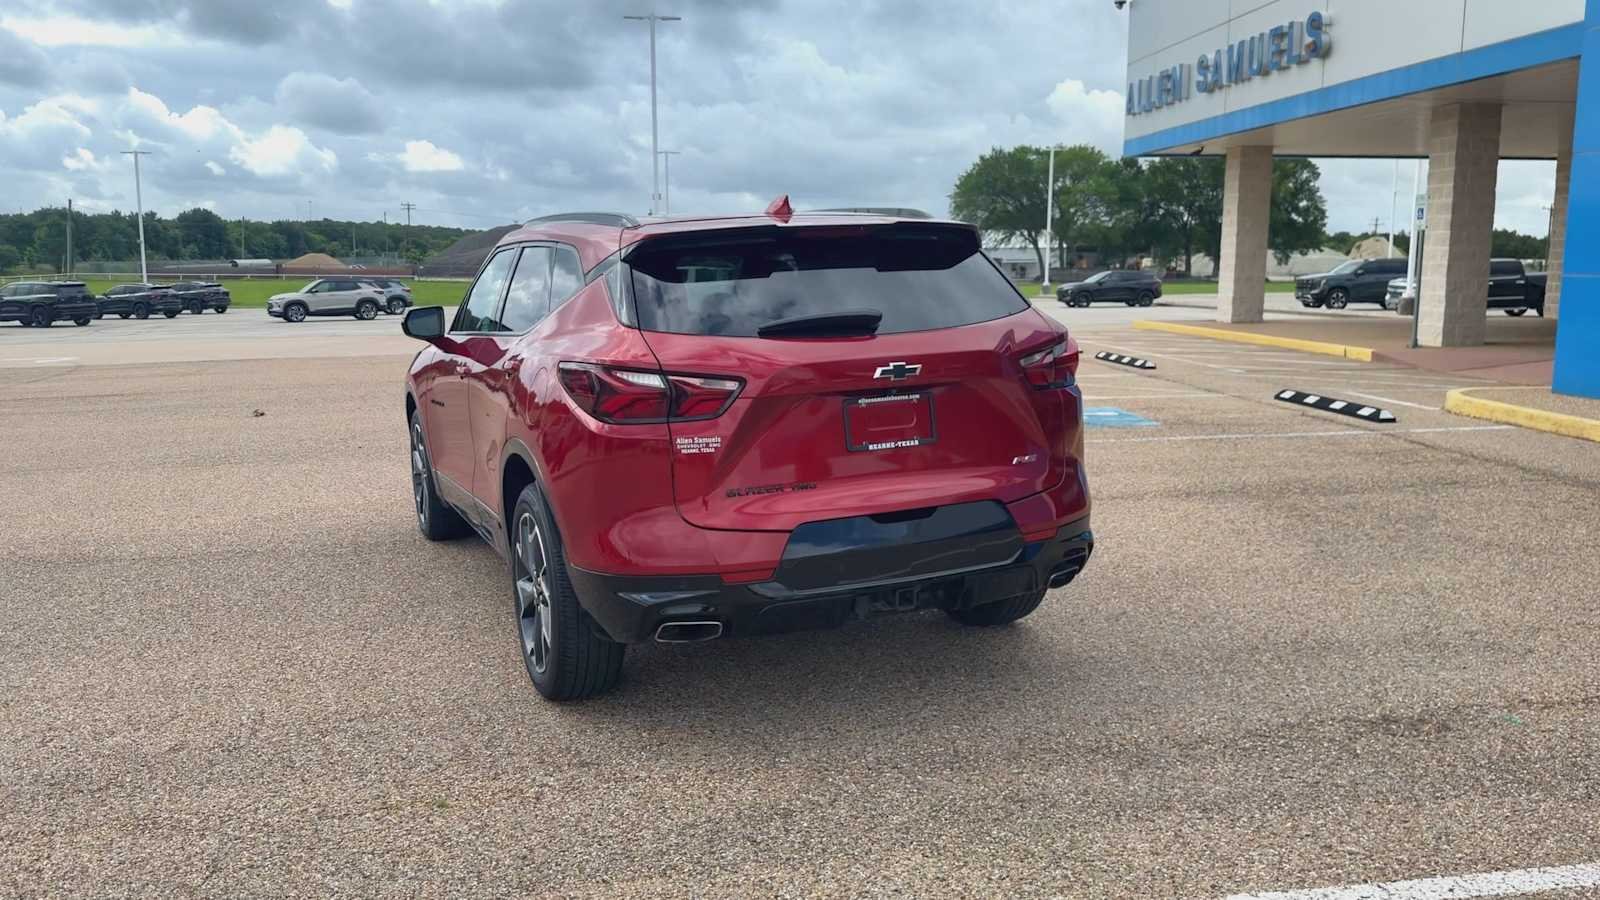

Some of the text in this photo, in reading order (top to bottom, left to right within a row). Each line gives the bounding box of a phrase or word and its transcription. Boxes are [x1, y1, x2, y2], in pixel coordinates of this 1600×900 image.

[1127, 11, 1332, 115] ALLEN SAMUELS
[726, 484, 784, 498] BLAZER
